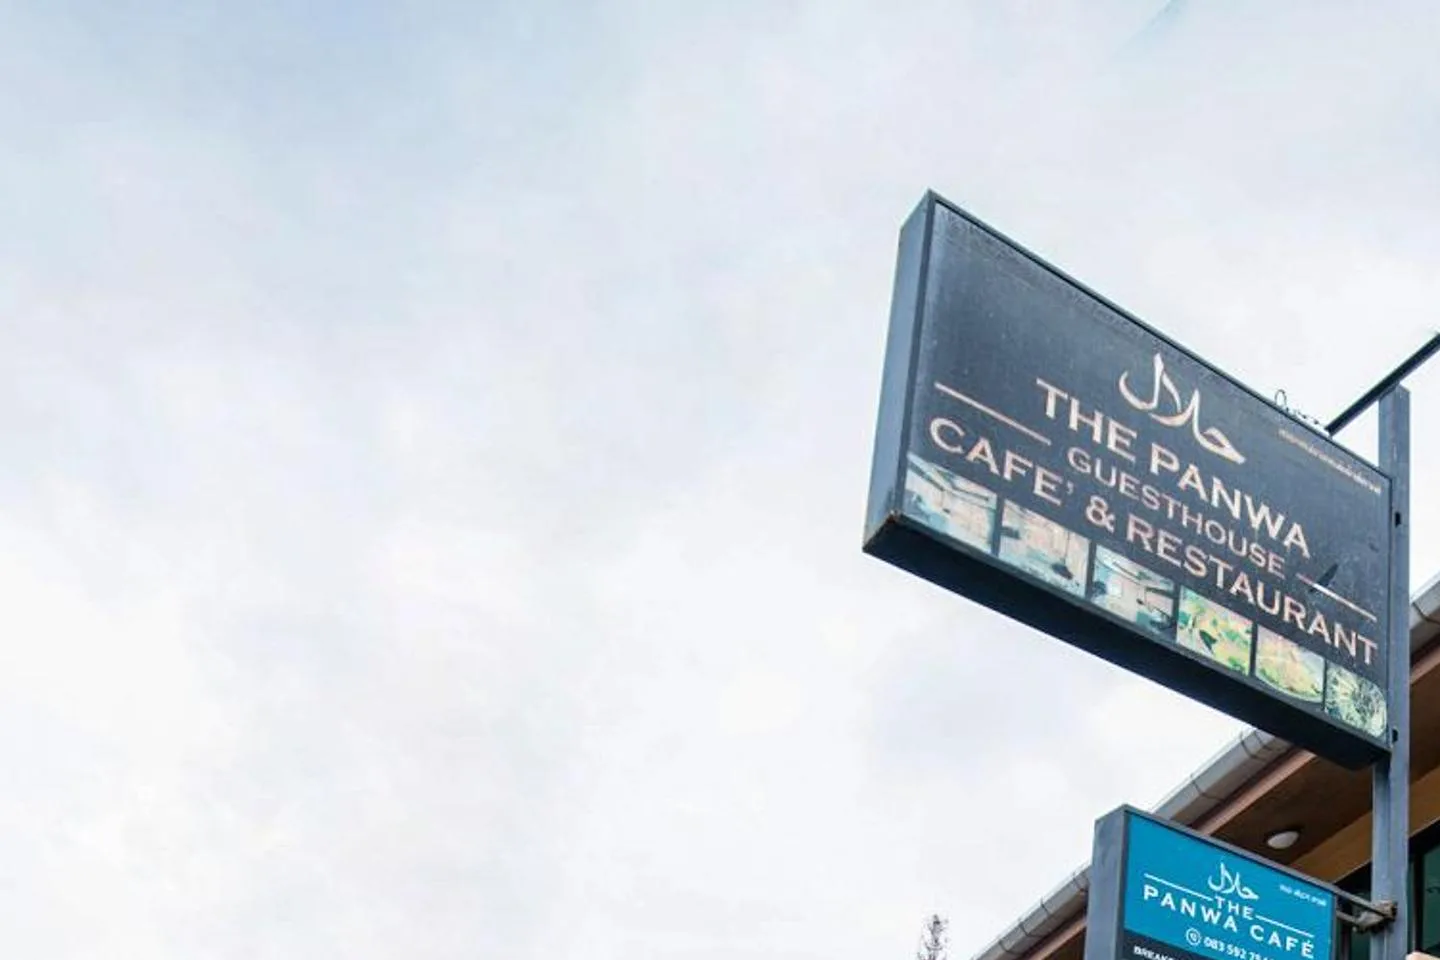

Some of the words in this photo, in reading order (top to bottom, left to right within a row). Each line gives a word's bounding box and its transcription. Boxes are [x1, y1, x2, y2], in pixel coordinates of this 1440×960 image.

[1036, 378, 1138, 462] THE
[1150, 445, 1310, 559] PANWA
[1067, 447, 1285, 580] GUESTHOUSE
[1085, 495, 1116, 533] &
[1126, 514, 1378, 665] RESTAURANT
[1143, 884, 1238, 933] PANWA
[1250, 925, 1315, 959] CAFÉ
[1214, 895, 1254, 920] THE
